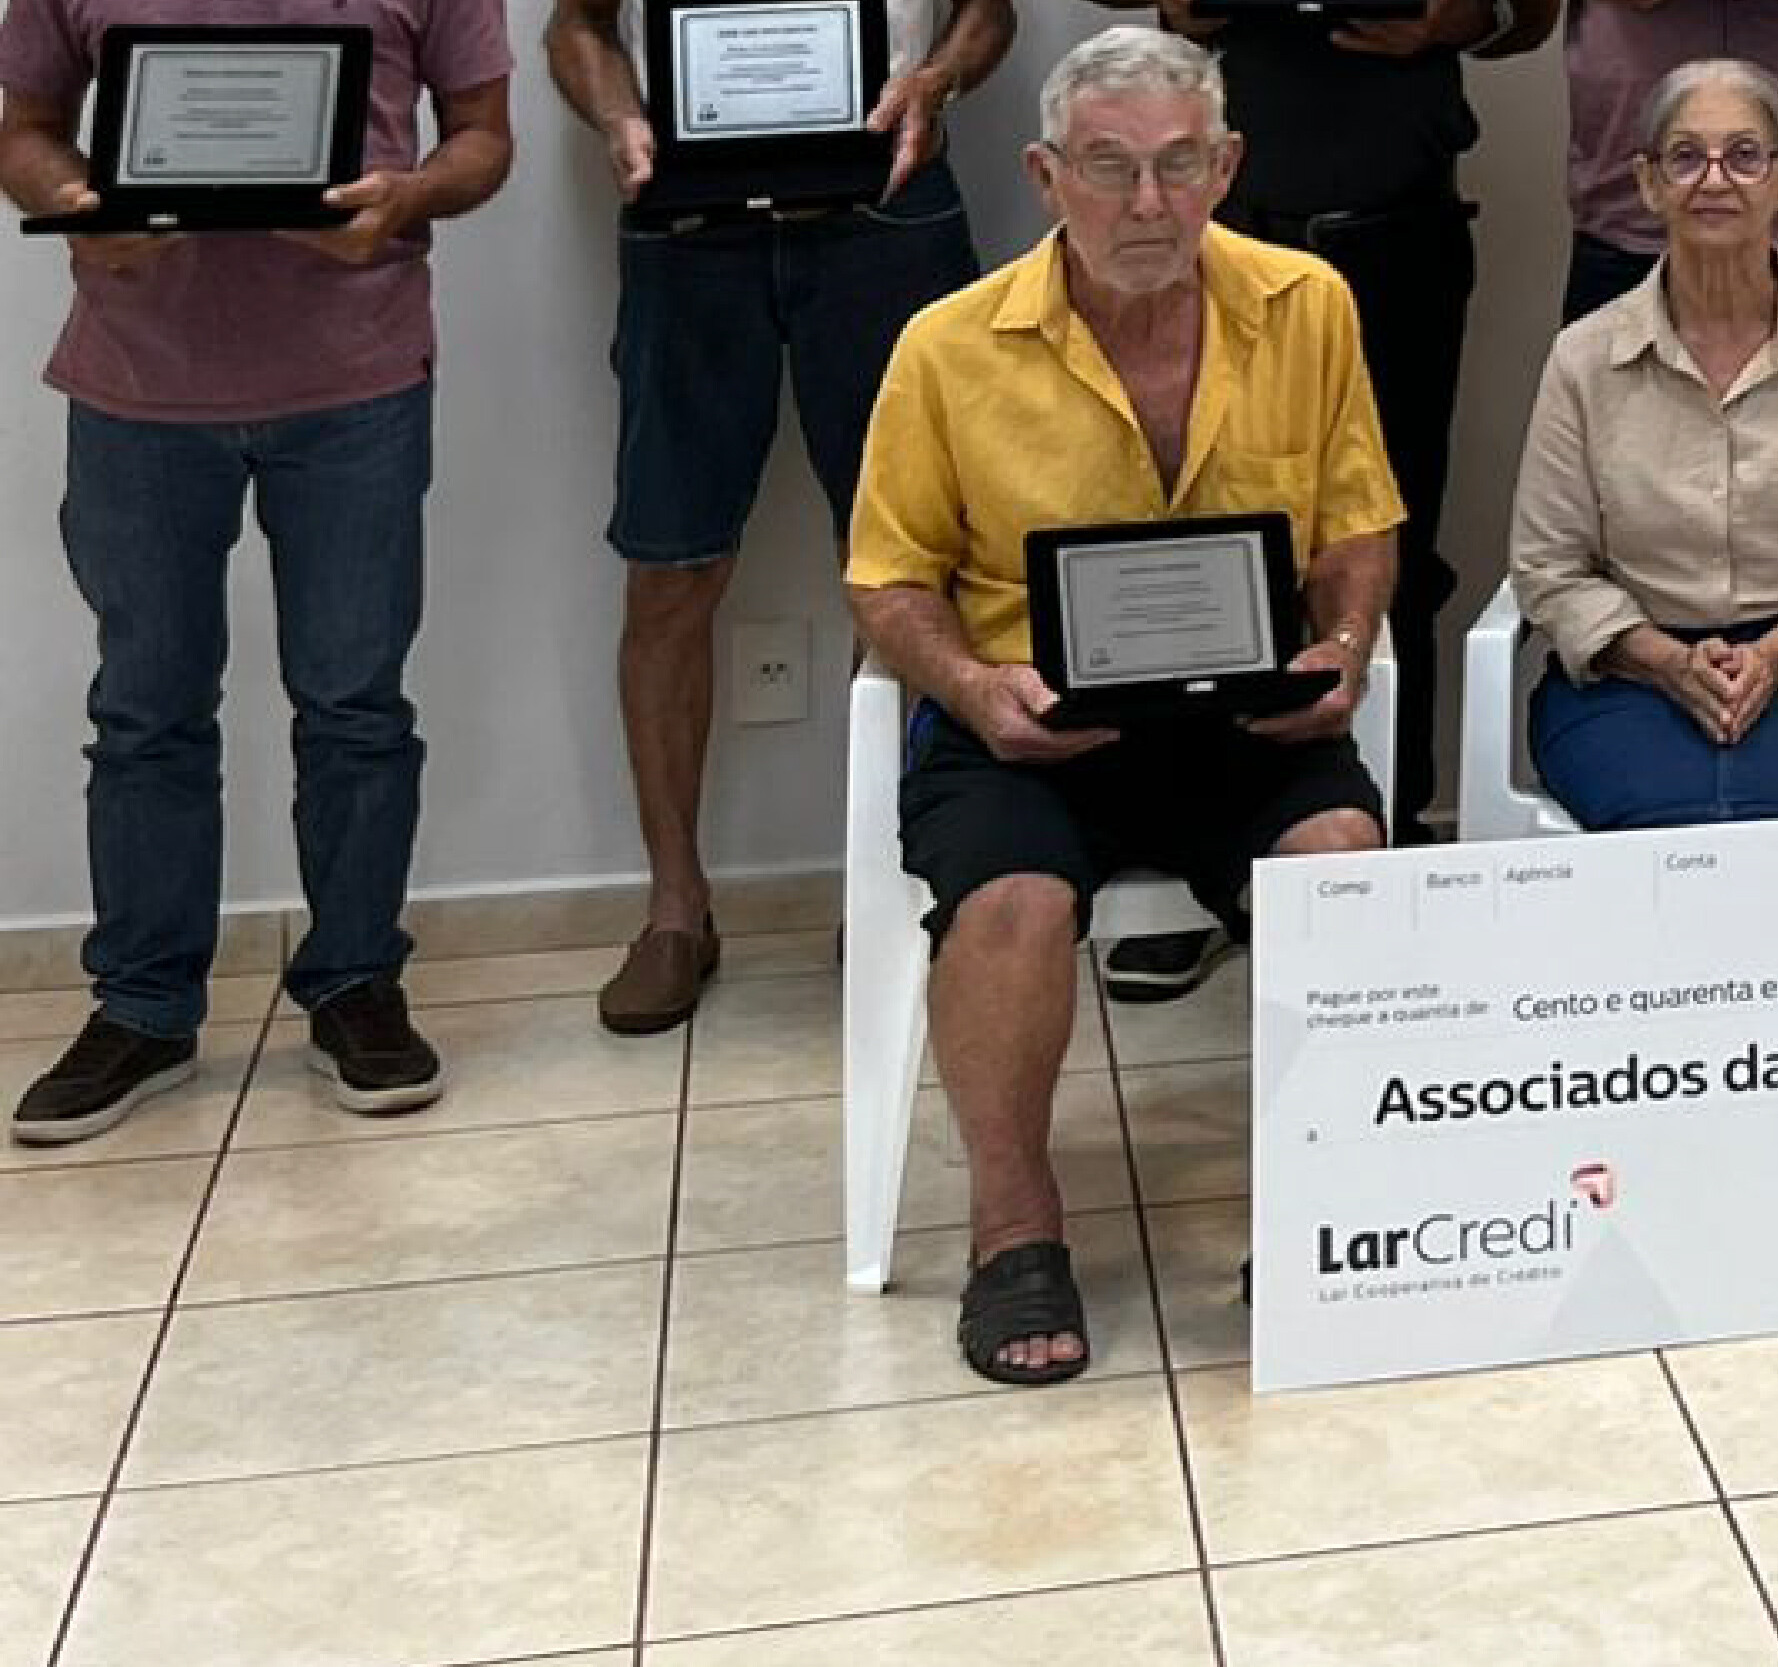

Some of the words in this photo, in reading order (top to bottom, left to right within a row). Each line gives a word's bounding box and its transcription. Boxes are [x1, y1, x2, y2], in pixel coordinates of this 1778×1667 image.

[1306, 991, 1361, 1010] Pague
[1366, 988, 1398, 1005] por
[1512, 992, 1599, 1022] Cento
[1605, 992, 1622, 1011] e
[1629, 980, 1754, 1013] quarenta
[1760, 980, 1778, 999] e
[1373, 1052, 1708, 1125] Associados
[1318, 1198, 1578, 1274] LarCredi
